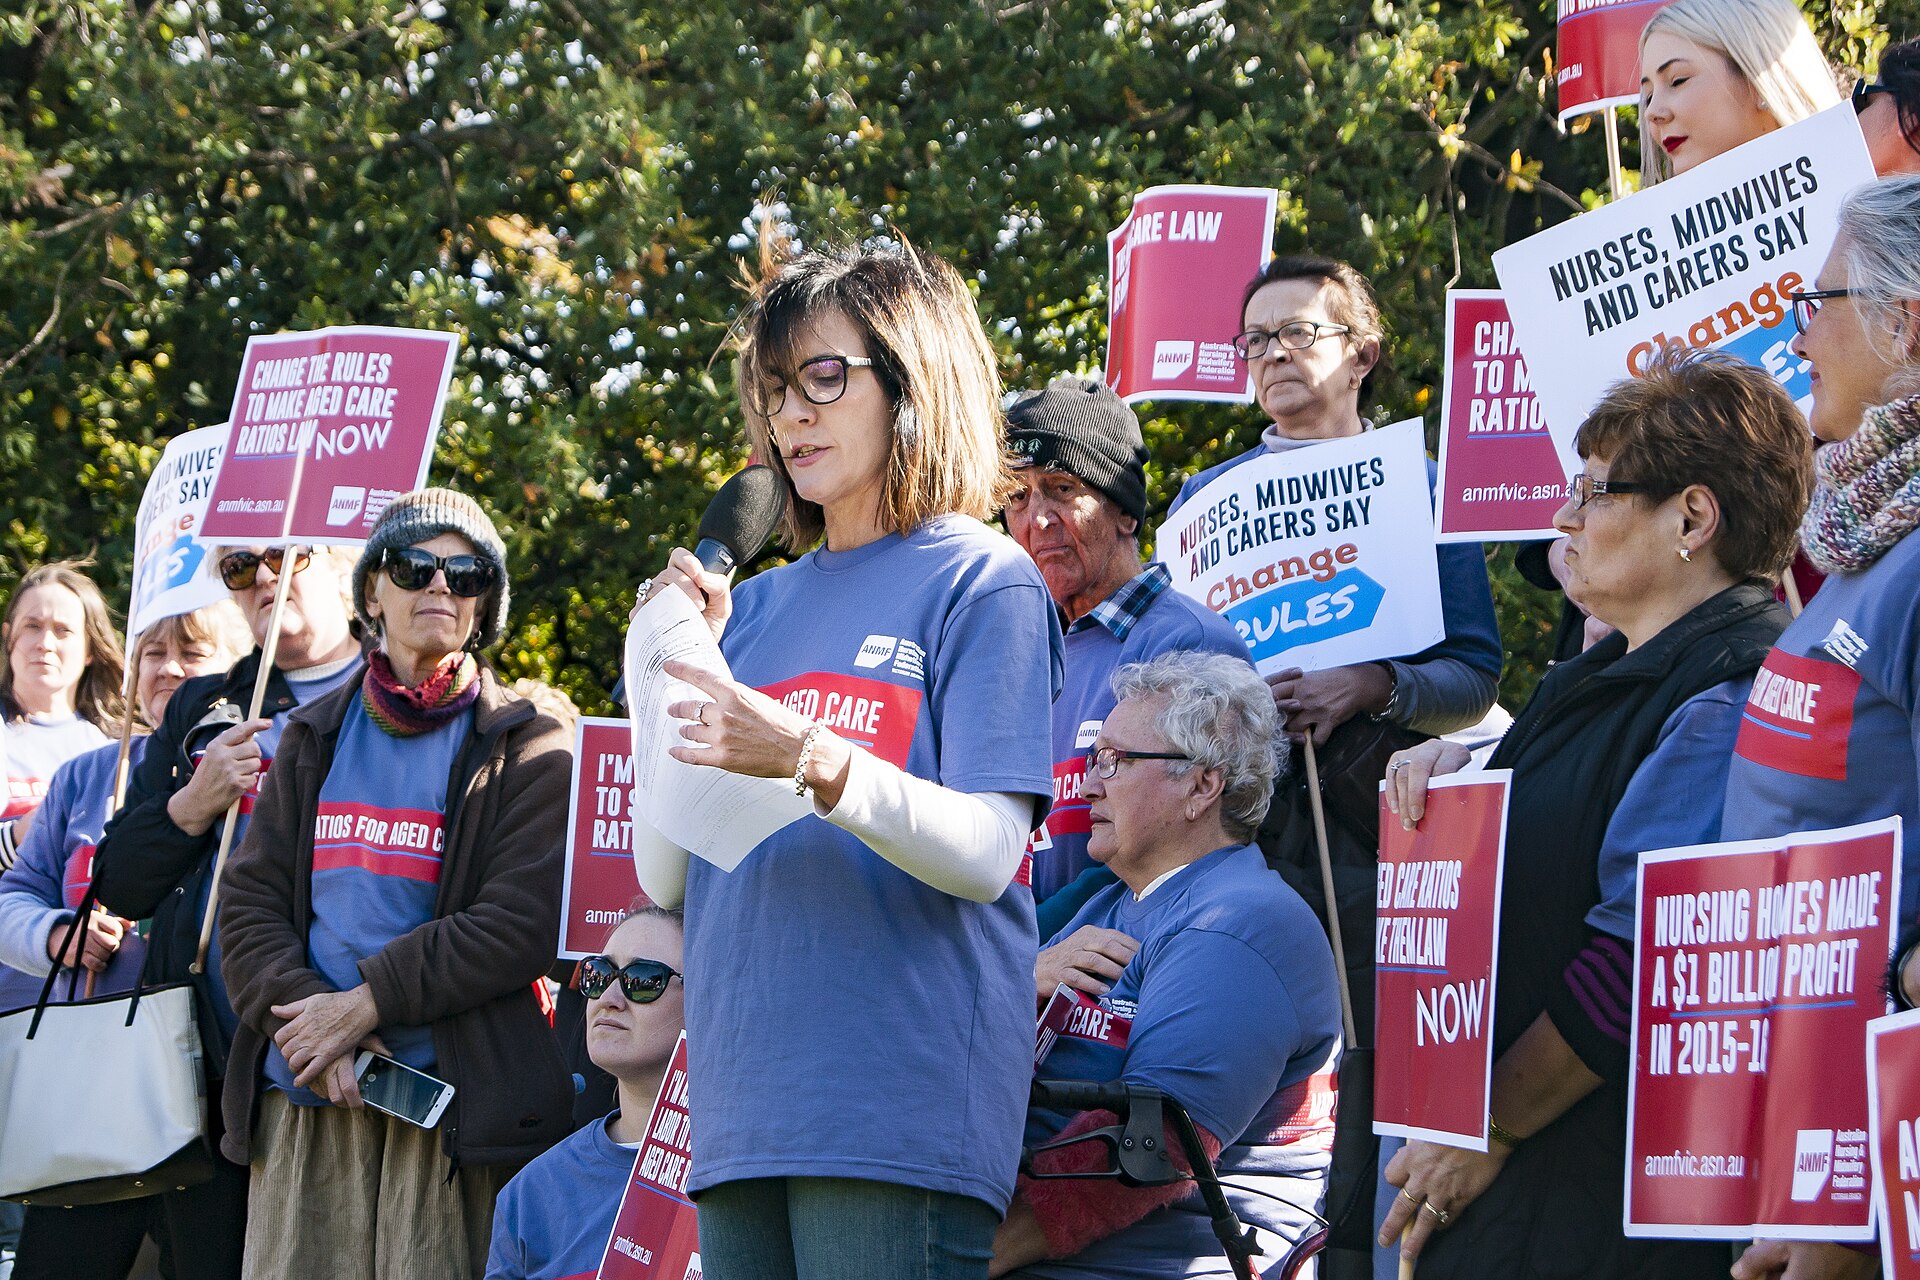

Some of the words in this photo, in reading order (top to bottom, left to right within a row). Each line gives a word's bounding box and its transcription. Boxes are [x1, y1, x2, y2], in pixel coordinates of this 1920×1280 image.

[1168, 210, 1223, 242] LAW
[1549, 226, 1670, 302] NURSES,
[1670, 155, 1818, 250] MIDWIVES
[1583, 282, 1639, 337] AND
[1643, 234, 1749, 309] CARERS
[1754, 206, 1809, 262] SAY
[251, 357, 309, 390] CHANGE
[307, 352, 331, 385] THE
[331, 351, 392, 385] RULES
[1157, 352, 1191, 363] ANMF
[1196, 364, 1236, 374] Federation
[1472, 359, 1505, 395] TO
[245, 392, 266, 422] TO
[264, 388, 306, 422] MAKE
[303, 385, 344, 417] AGED
[344, 386, 399, 418] CARE
[235, 423, 289, 455] RATIOS
[286, 418, 319, 453] LAW
[315, 419, 393, 461] NOW
[179, 474, 213, 504] SAY
[216, 497, 285, 513] anmfvic.asn.au
[332, 498, 361, 510] ANMF
[1180, 492, 1249, 558] NURSES,
[1255, 456, 1385, 511] MIDWIVES
[1190, 537, 1221, 582] AND
[1227, 508, 1316, 557] CARERS
[1324, 495, 1371, 533] SAY
[1206, 542, 1359, 613] Change
[861, 644, 892, 657] ANMF
[823, 691, 884, 735] CARE
[597, 753, 633, 784] I'M
[595, 786, 621, 817] TO
[354, 815, 388, 846] FOR
[388, 821, 429, 849] AGED
[1417, 860, 1462, 910] RATIOS
[1654, 888, 1751, 947] NURSING
[1756, 879, 1824, 940] HOMES
[1826, 871, 1882, 932] MADE
[1416, 917, 1448, 967] LAW
[1651, 956, 1667, 1007] A
[1672, 948, 1700, 1011] $1
[1783, 938, 1859, 997] PROFIT
[1069, 1006, 1114, 1041] CARE
[1416, 977, 1486, 1047] NOW
[1650, 1023, 1672, 1075] IN
[652, 1106, 682, 1146] LABOR
[638, 1144, 666, 1181] AGED
[657, 1149, 686, 1190] CARE
[1645, 1150, 1744, 1176] anmfvic.asn.au
[1797, 1152, 1829, 1172] ANMF
